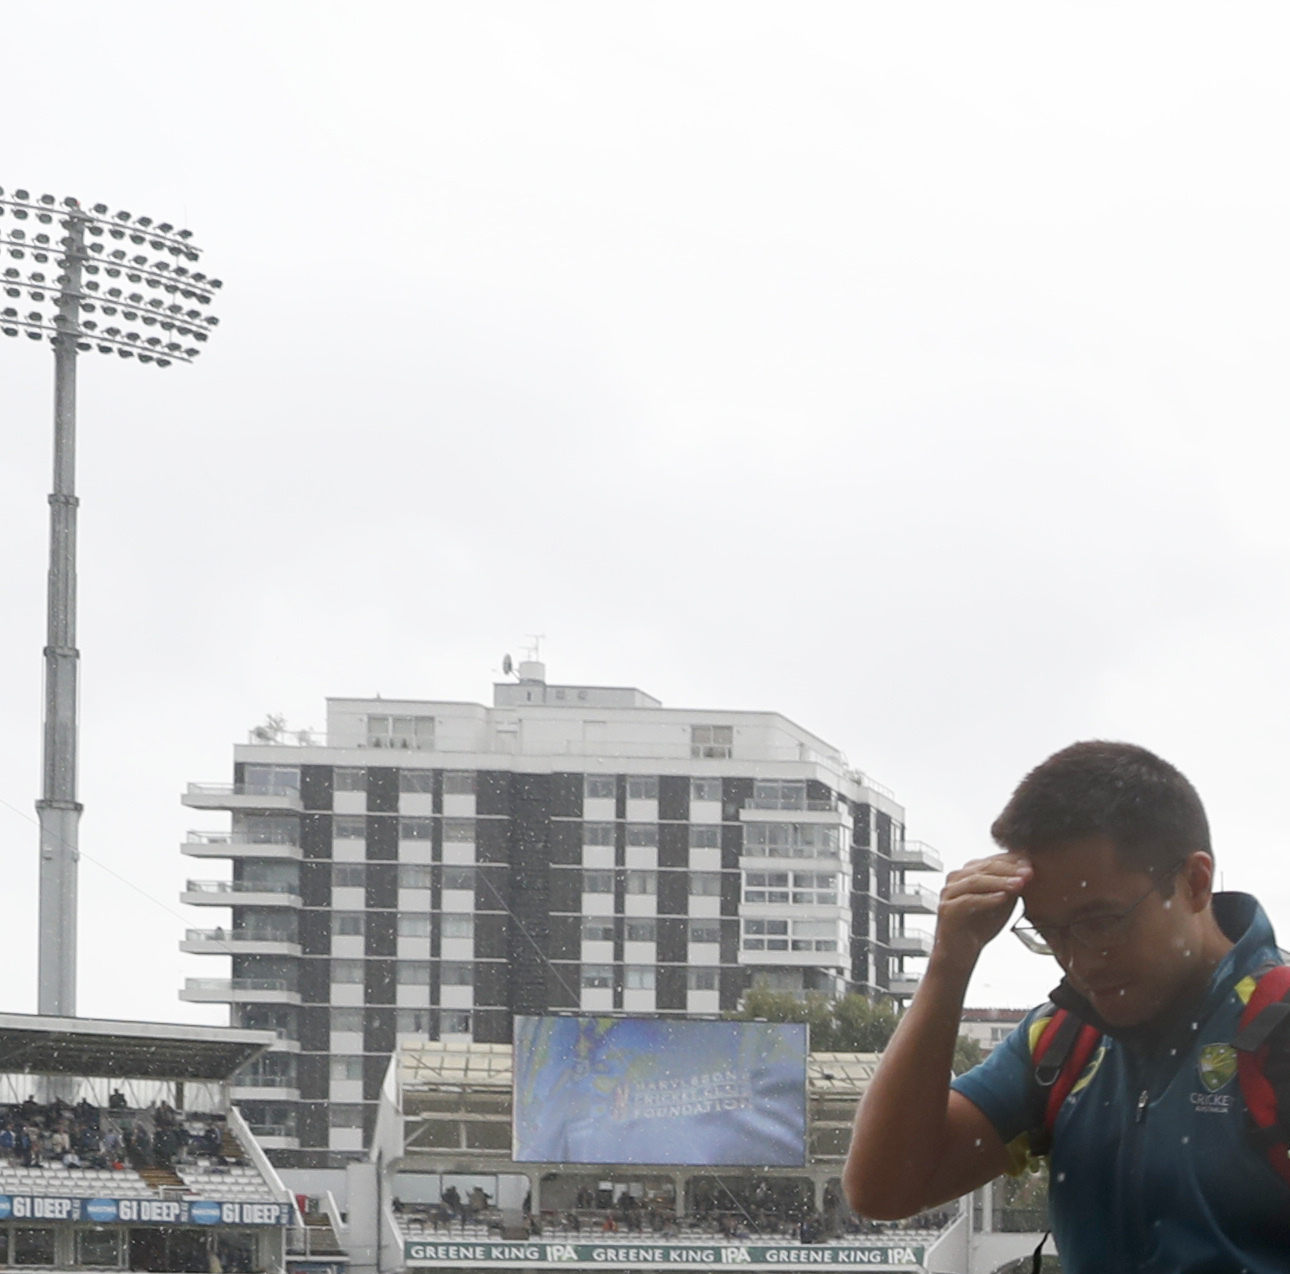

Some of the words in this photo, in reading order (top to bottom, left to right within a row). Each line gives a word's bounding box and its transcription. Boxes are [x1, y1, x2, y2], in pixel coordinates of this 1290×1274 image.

[12, 1198, 31, 1217] 61
[34, 1199, 72, 1219] DEEP
[118, 1200, 139, 1220] 61
[141, 1201, 180, 1221] DEEP
[222, 1203, 240, 1222] 61
[243, 1203, 280, 1223] DEEP
[411, 1245, 485, 1259] GREENE
[491, 1246, 540, 1260] KING
[546, 1245, 578, 1261] IPA
[592, 1248, 663, 1261] GREENE
[669, 1249, 715, 1262] KING
[721, 1248, 751, 1263] IPA
[765, 1250, 832, 1263] GREENE
[838, 1250, 881, 1263] KING
[887, 1248, 916, 1264] IPA
